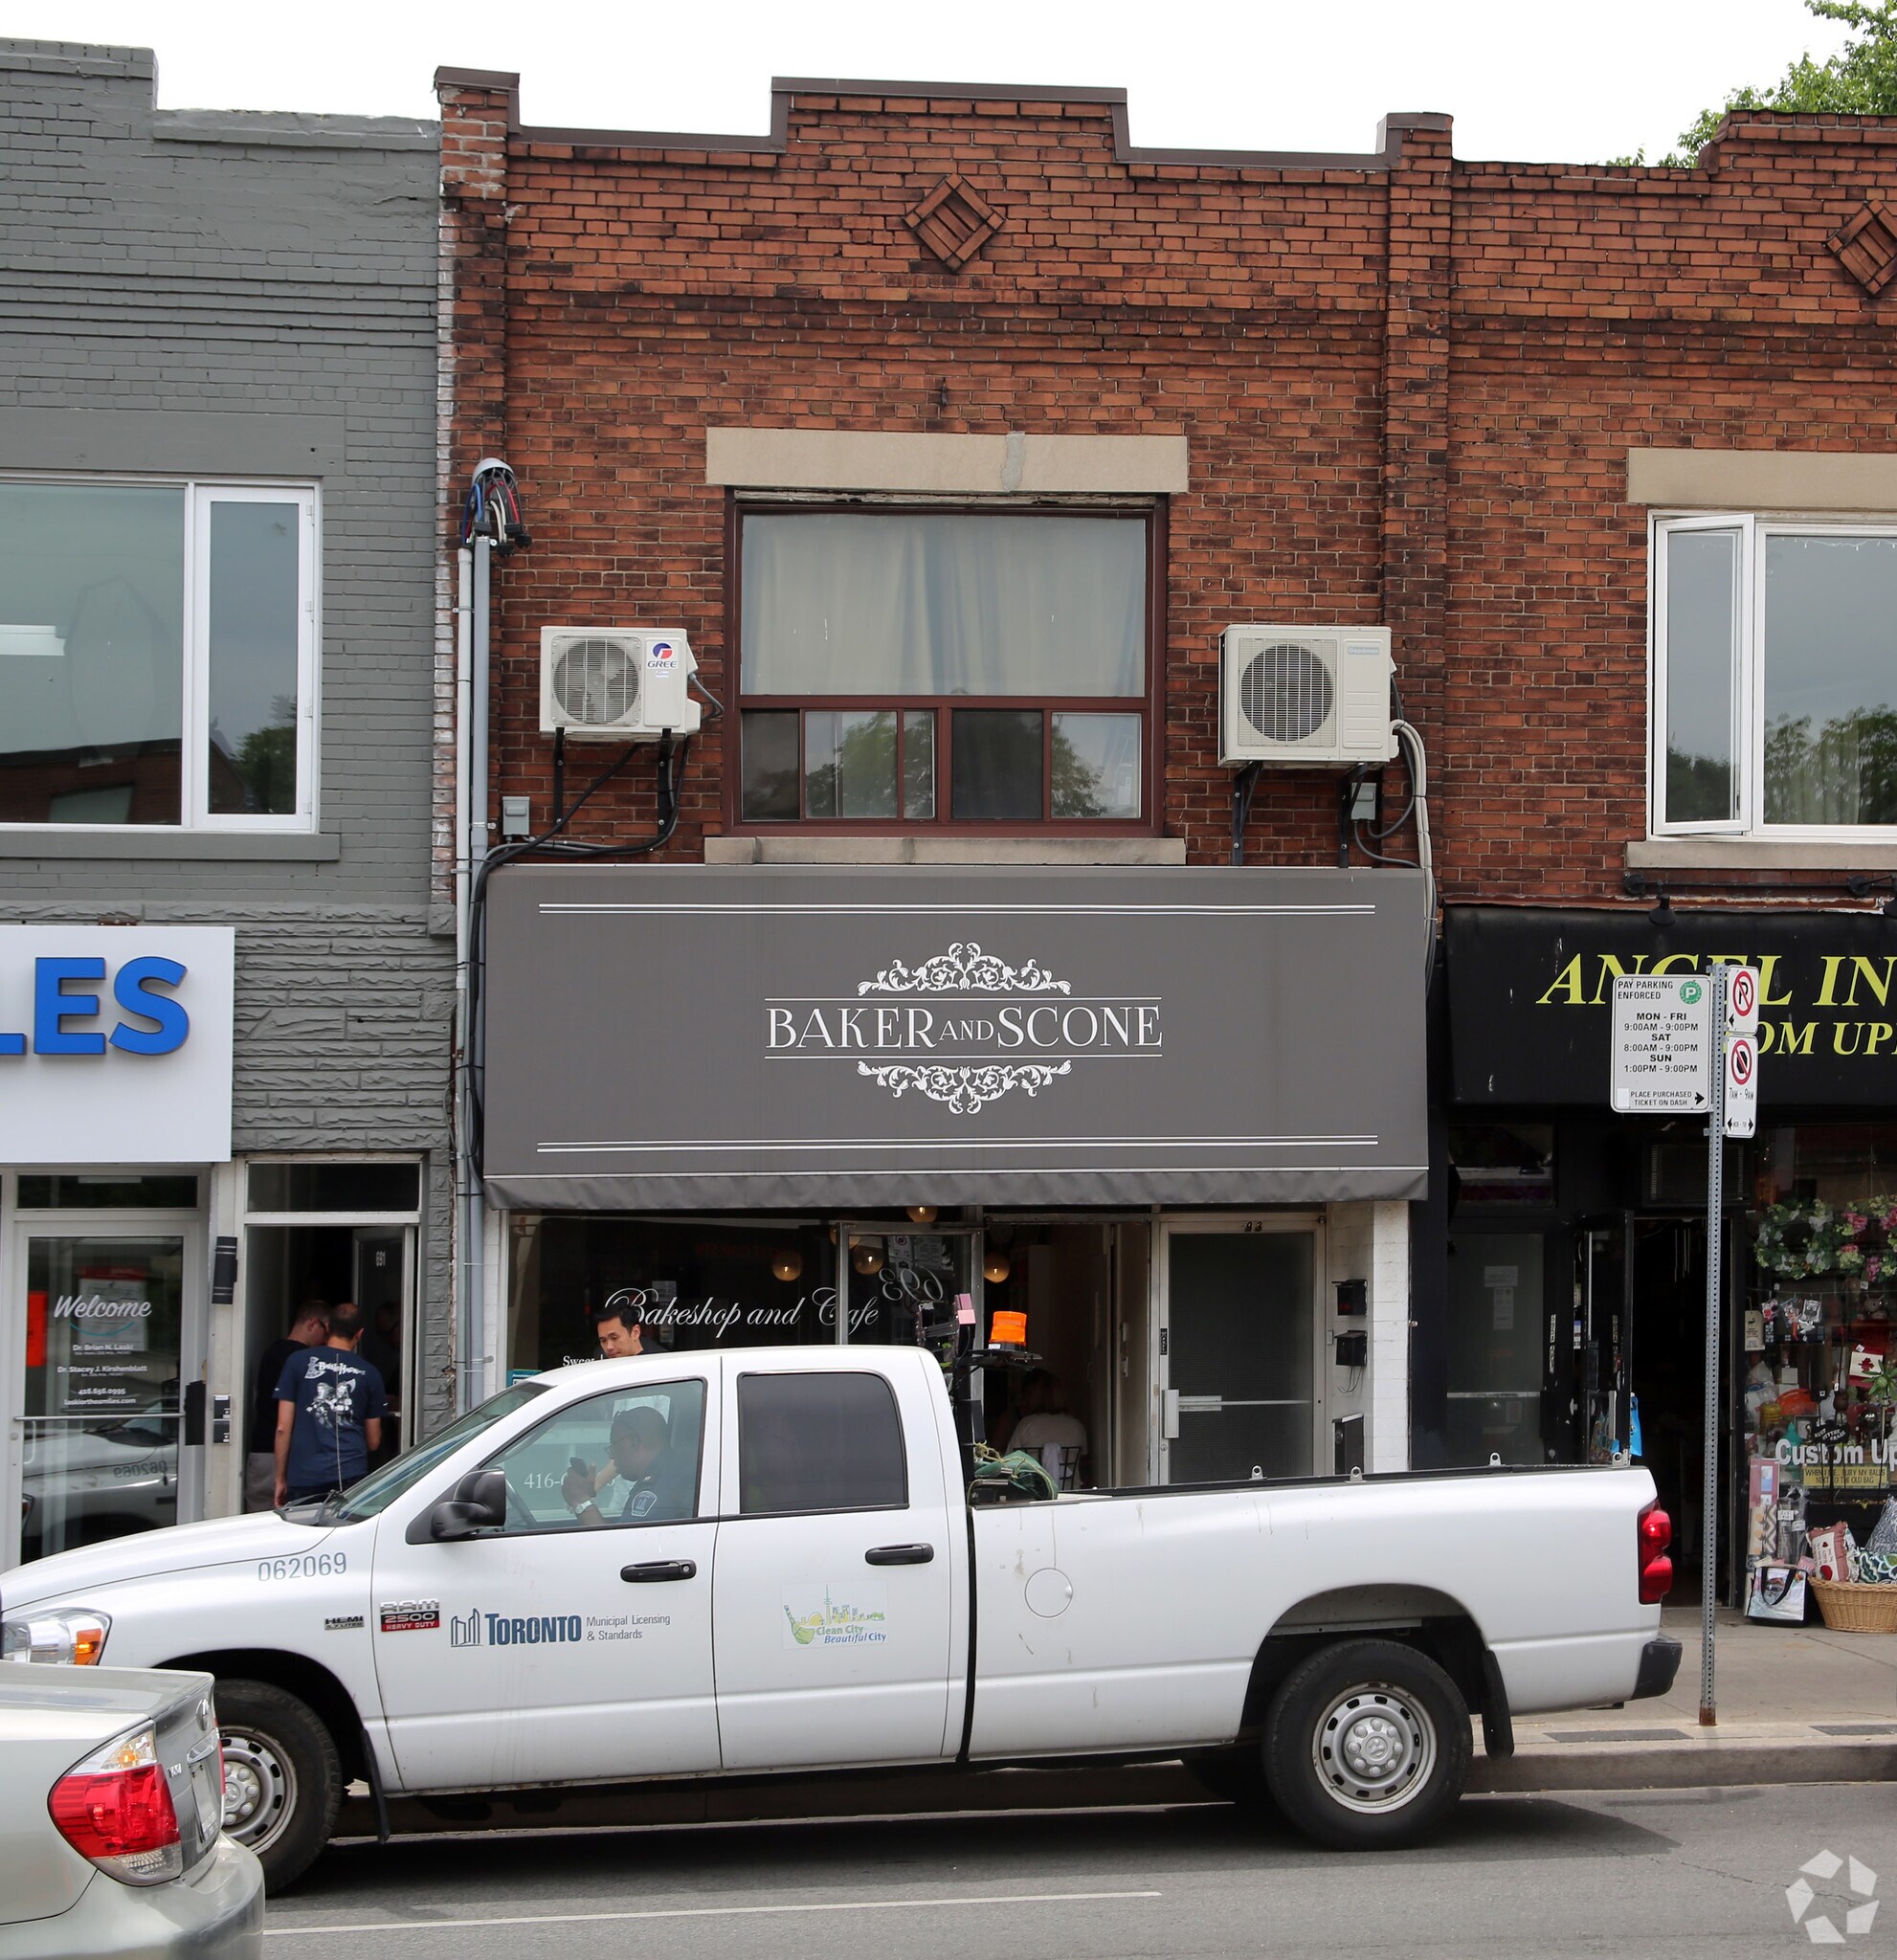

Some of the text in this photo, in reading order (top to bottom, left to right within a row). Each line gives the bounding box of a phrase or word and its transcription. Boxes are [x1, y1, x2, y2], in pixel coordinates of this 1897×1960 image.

[647, 660, 678, 669] GREE
[1618, 980, 1674, 990] PAY PARKING
[1618, 991, 1662, 1000] ENFORCED
[0, 955, 190, 1056] ES
[1636, 1013, 1661, 1021] MON
[1670, 1013, 1687, 1021] FRI
[766, 1005, 1163, 1050] BAKER AND SCONE
[1624, 1023, 1658, 1032] 9:00AM
[1665, 1023, 1699, 1032] 9:00PM
[1651, 1033, 1671, 1041] SAT
[1832, 1021, 1897, 1056] UP
[1623, 1043, 1658, 1052] 8:00AM
[1665, 1043, 1698, 1052] 9:00PM
[1649, 1054, 1672, 1062] SUN
[1624, 1064, 1657, 1073] 1:00PM
[1665, 1064, 1698, 1073] 9:00PM
[1729, 1087, 1738, 1100] 7AM
[1745, 1088, 1754, 1101] 9AM
[54, 1294, 153, 1318] Welcome
[605, 1287, 879, 1339] Bakeshop and Cafe
[69, 1366, 95, 1374] Stacey
[257, 1552, 347, 1582] 062069
[380, 1598, 439, 1614] RAM
[324, 1615, 364, 1625] HEMI
[384, 1612, 435, 1624] 2500
[414, 1620, 435, 1629] DUTY
[484, 1612, 671, 1646] TORONTO Municipal Licensing
[815, 1623, 864, 1636] Clean City
[586, 1629, 643, 1641] & Standards
[824, 1631, 887, 1644] Beautiful City
